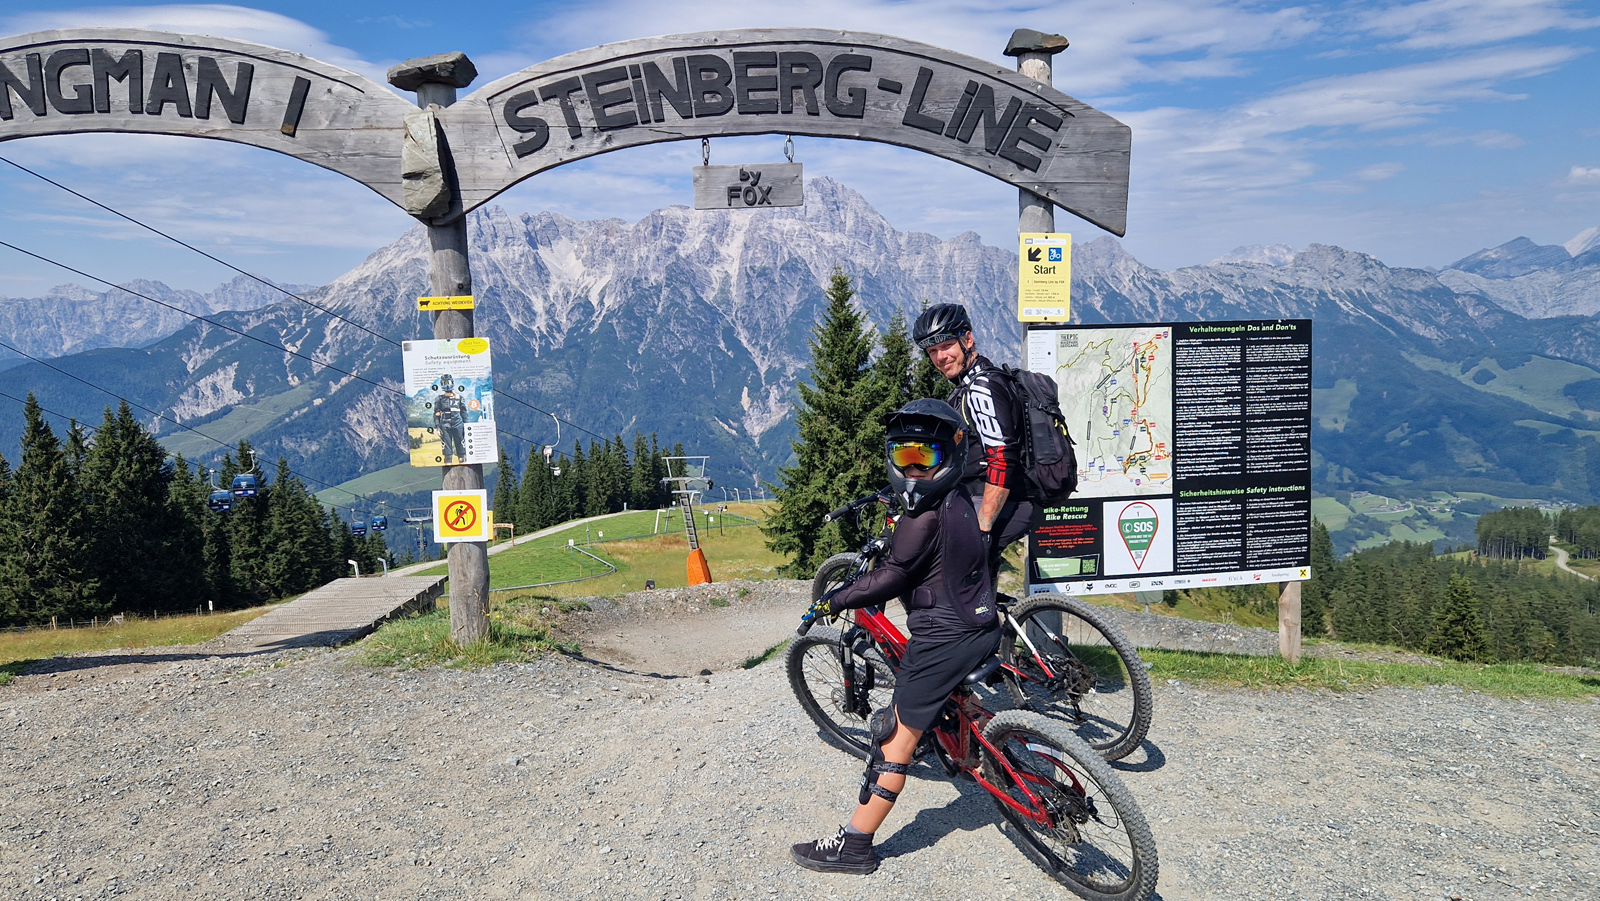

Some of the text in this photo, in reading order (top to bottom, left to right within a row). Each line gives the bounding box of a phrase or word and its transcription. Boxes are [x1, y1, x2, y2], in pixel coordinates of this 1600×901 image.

[739, 167, 762, 187] by
[727, 186, 773, 207] FOX
[1034, 264, 1056, 275] Start
[1189, 325, 1246, 334] Verhaltensregeln
[1179, 488, 1245, 498] Sicherheitshinweise
[1246, 487, 1267, 495] Safety
[1043, 505, 1089, 514] Bike-Rettung
[1045, 513, 1061, 521] Bike
[1133, 521, 1154, 533] SOS
